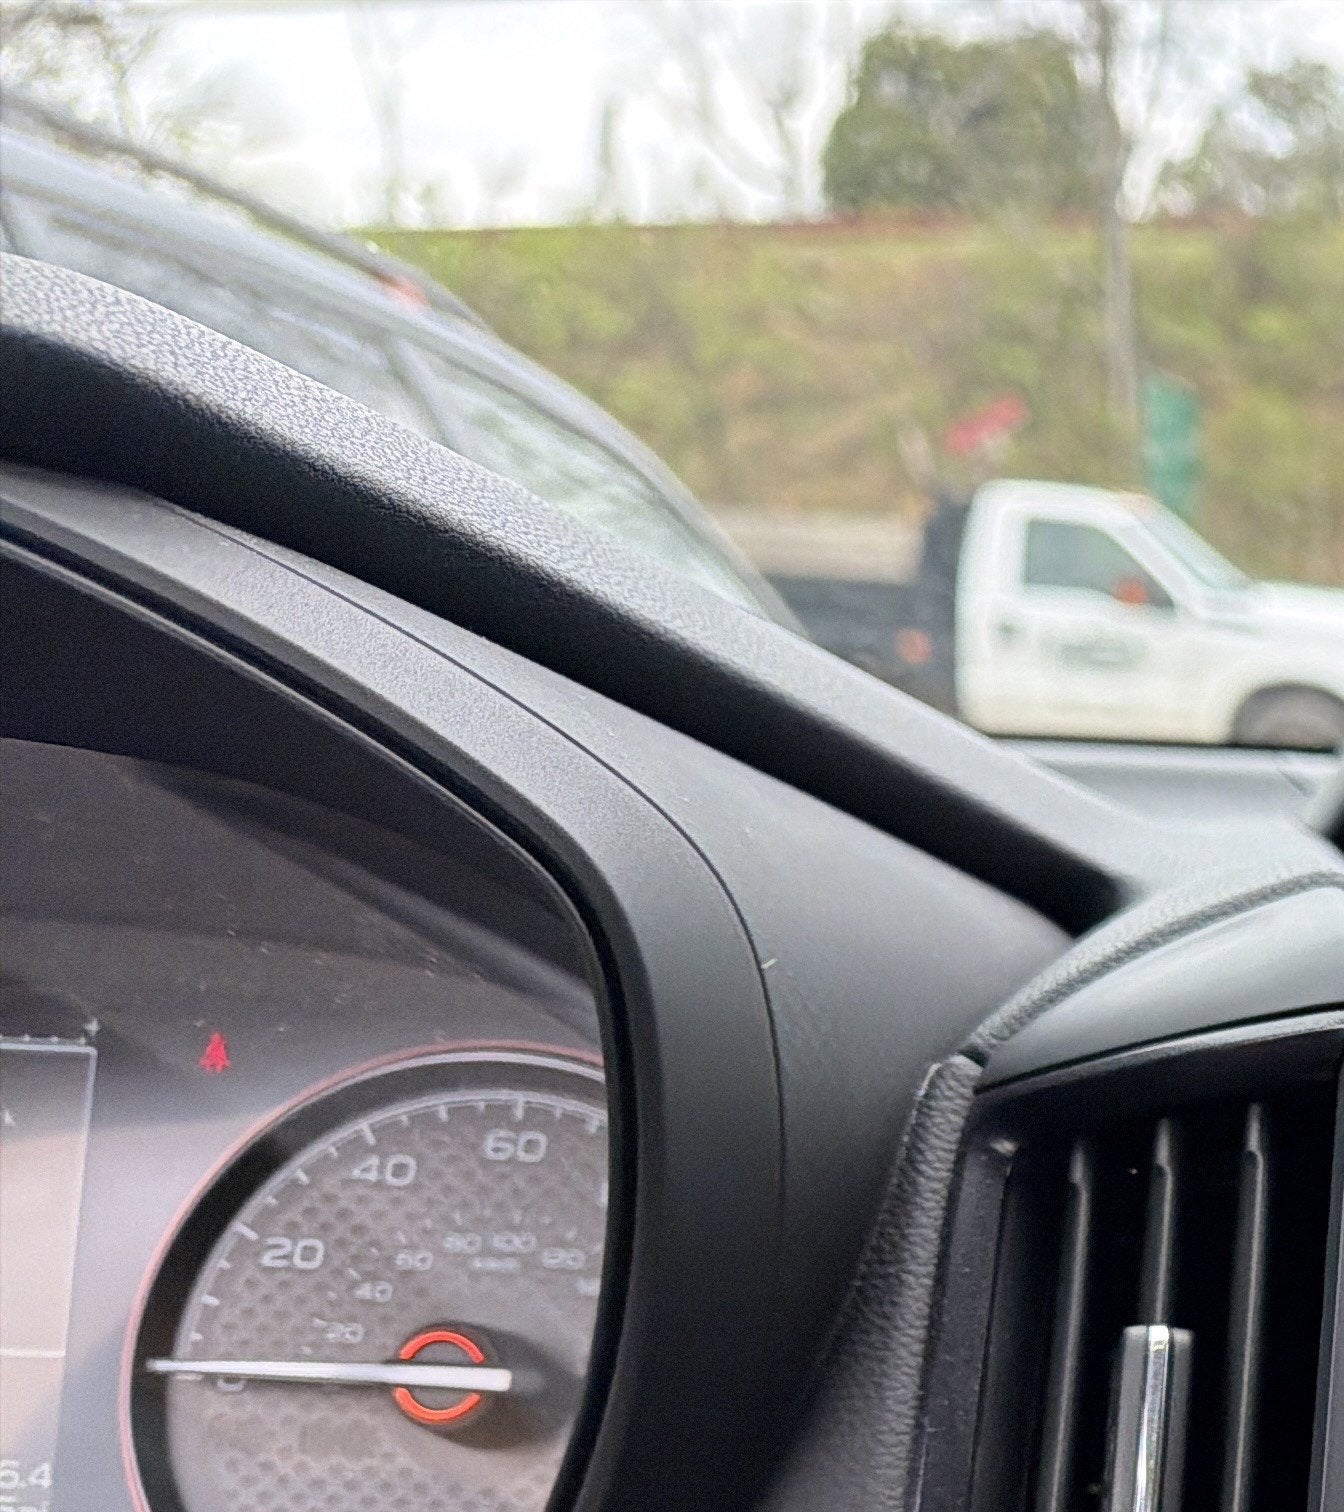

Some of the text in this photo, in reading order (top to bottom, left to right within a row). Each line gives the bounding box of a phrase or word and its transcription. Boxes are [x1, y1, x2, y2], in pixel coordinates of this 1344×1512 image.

[485, 1131, 548, 1162] 60
[352, 1155, 416, 1186] 40
[261, 1239, 324, 1270] 20
[354, 1281, 393, 1302] 40
